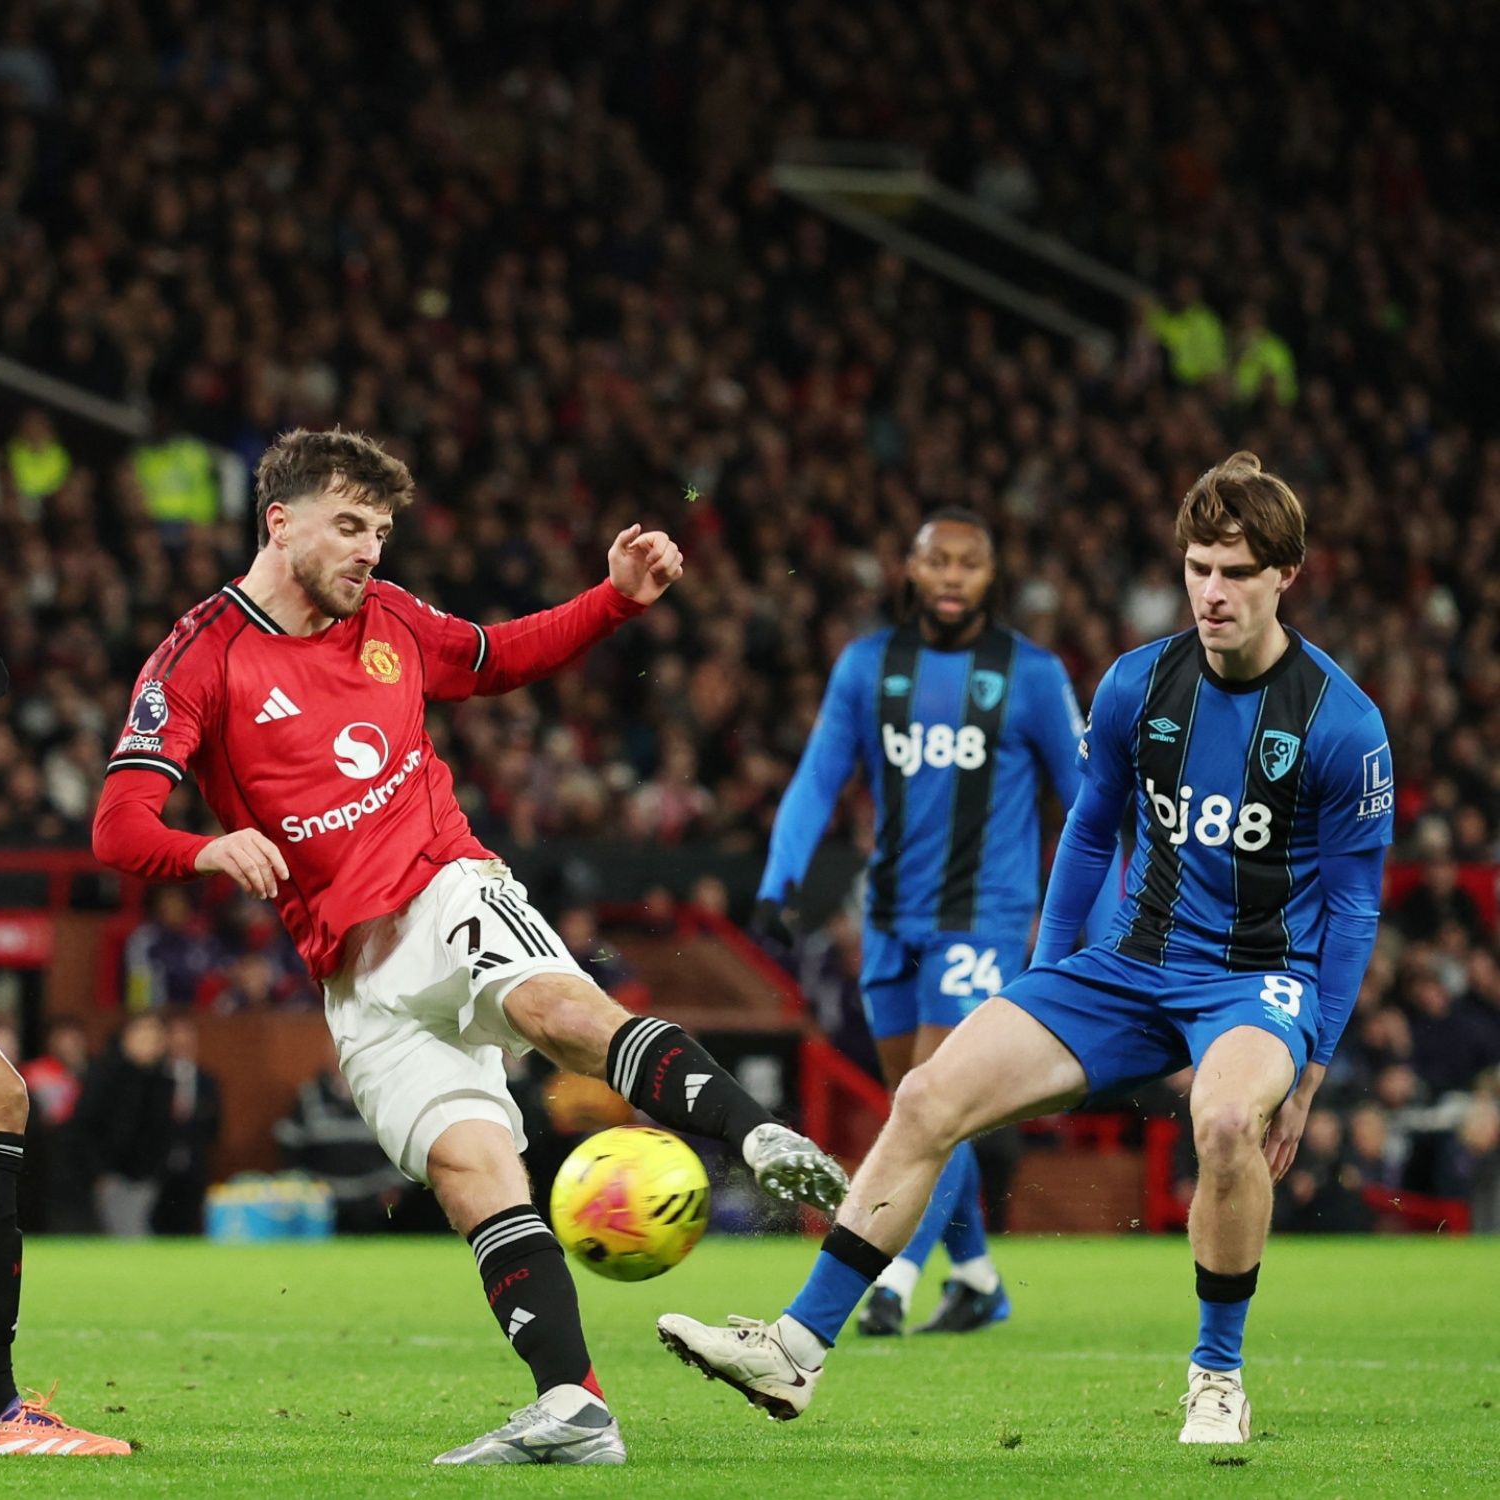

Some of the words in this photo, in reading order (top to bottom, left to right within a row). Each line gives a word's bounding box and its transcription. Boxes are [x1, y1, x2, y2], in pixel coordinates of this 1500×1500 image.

[882, 721, 987, 777] bj88
[1149, 732, 1176, 743] umbro
[1146, 778, 1272, 851] bj88
[1357, 792, 1393, 816] LEO
[446, 916, 480, 955] 7
[940, 943, 1003, 997] 24
[1260, 975, 1303, 1018] 8
